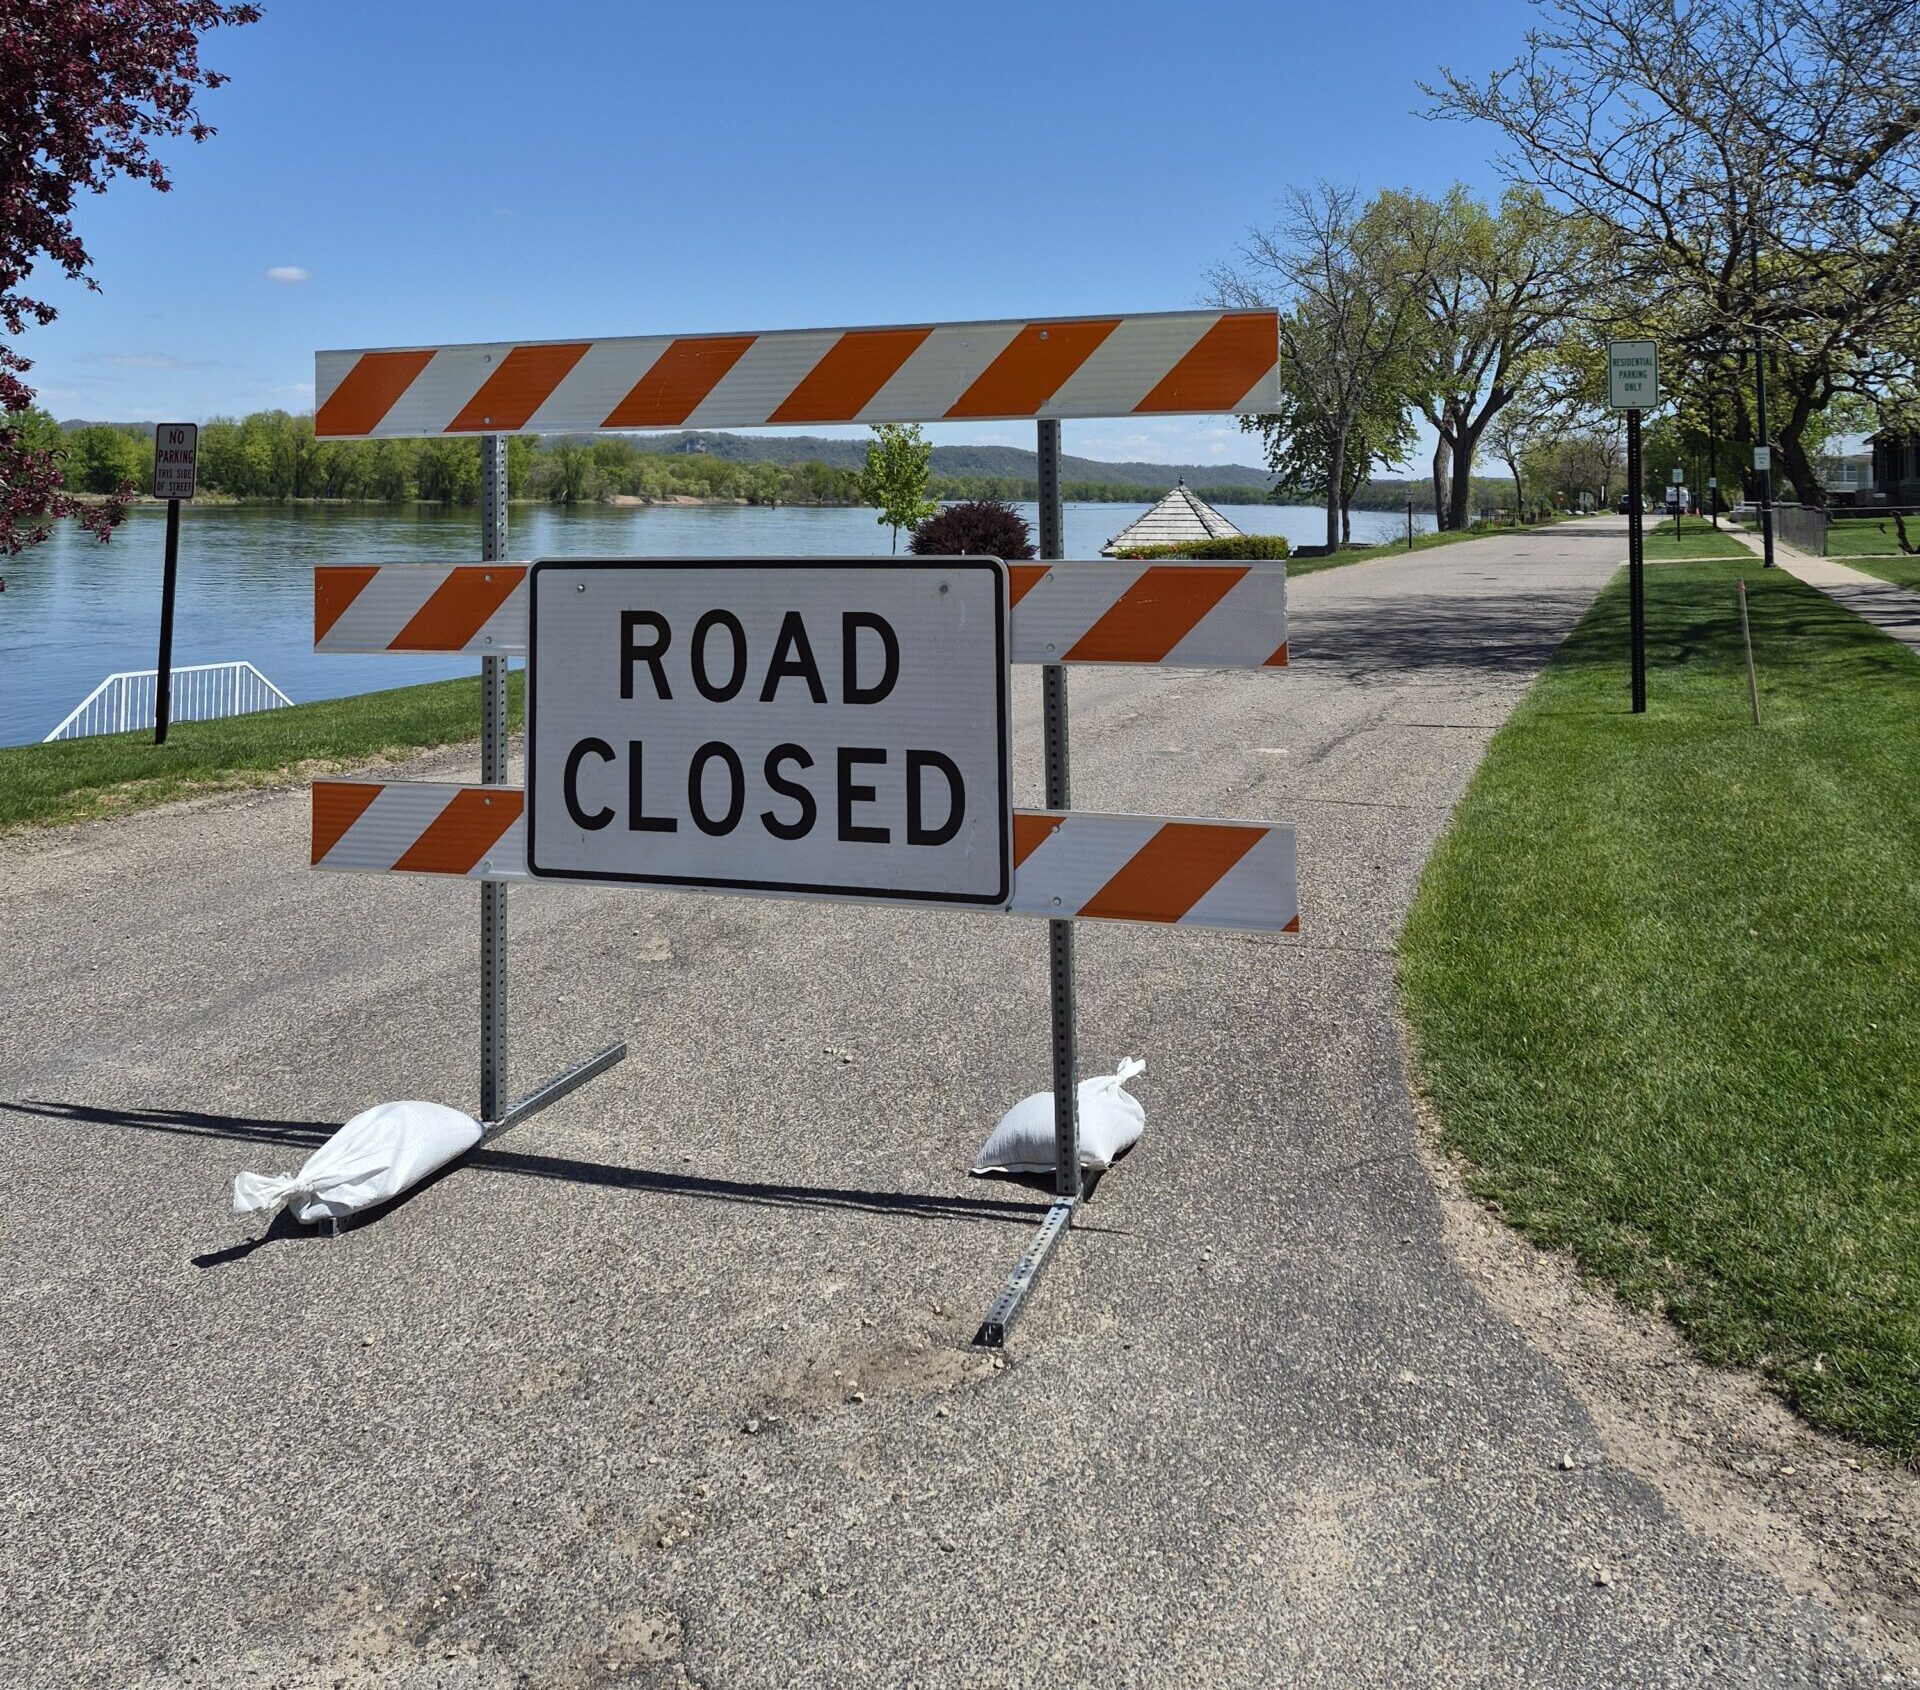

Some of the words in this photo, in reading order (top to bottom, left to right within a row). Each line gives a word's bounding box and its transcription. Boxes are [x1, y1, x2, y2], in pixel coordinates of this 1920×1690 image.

[1612, 357, 1654, 367] RESIDENTIAL
[1618, 370, 1648, 379] PARKING
[1624, 383, 1642, 391] ONLY
[169, 430, 184, 444] NO
[158, 449, 193, 464] PARKING
[158, 469, 172, 479] THIS
[176, 469, 191, 479] SIDE
[156, 482, 164, 491] OF
[168, 482, 191, 492] STREET
[620, 609, 900, 704] ROAD
[563, 737, 965, 846] CLOSED
